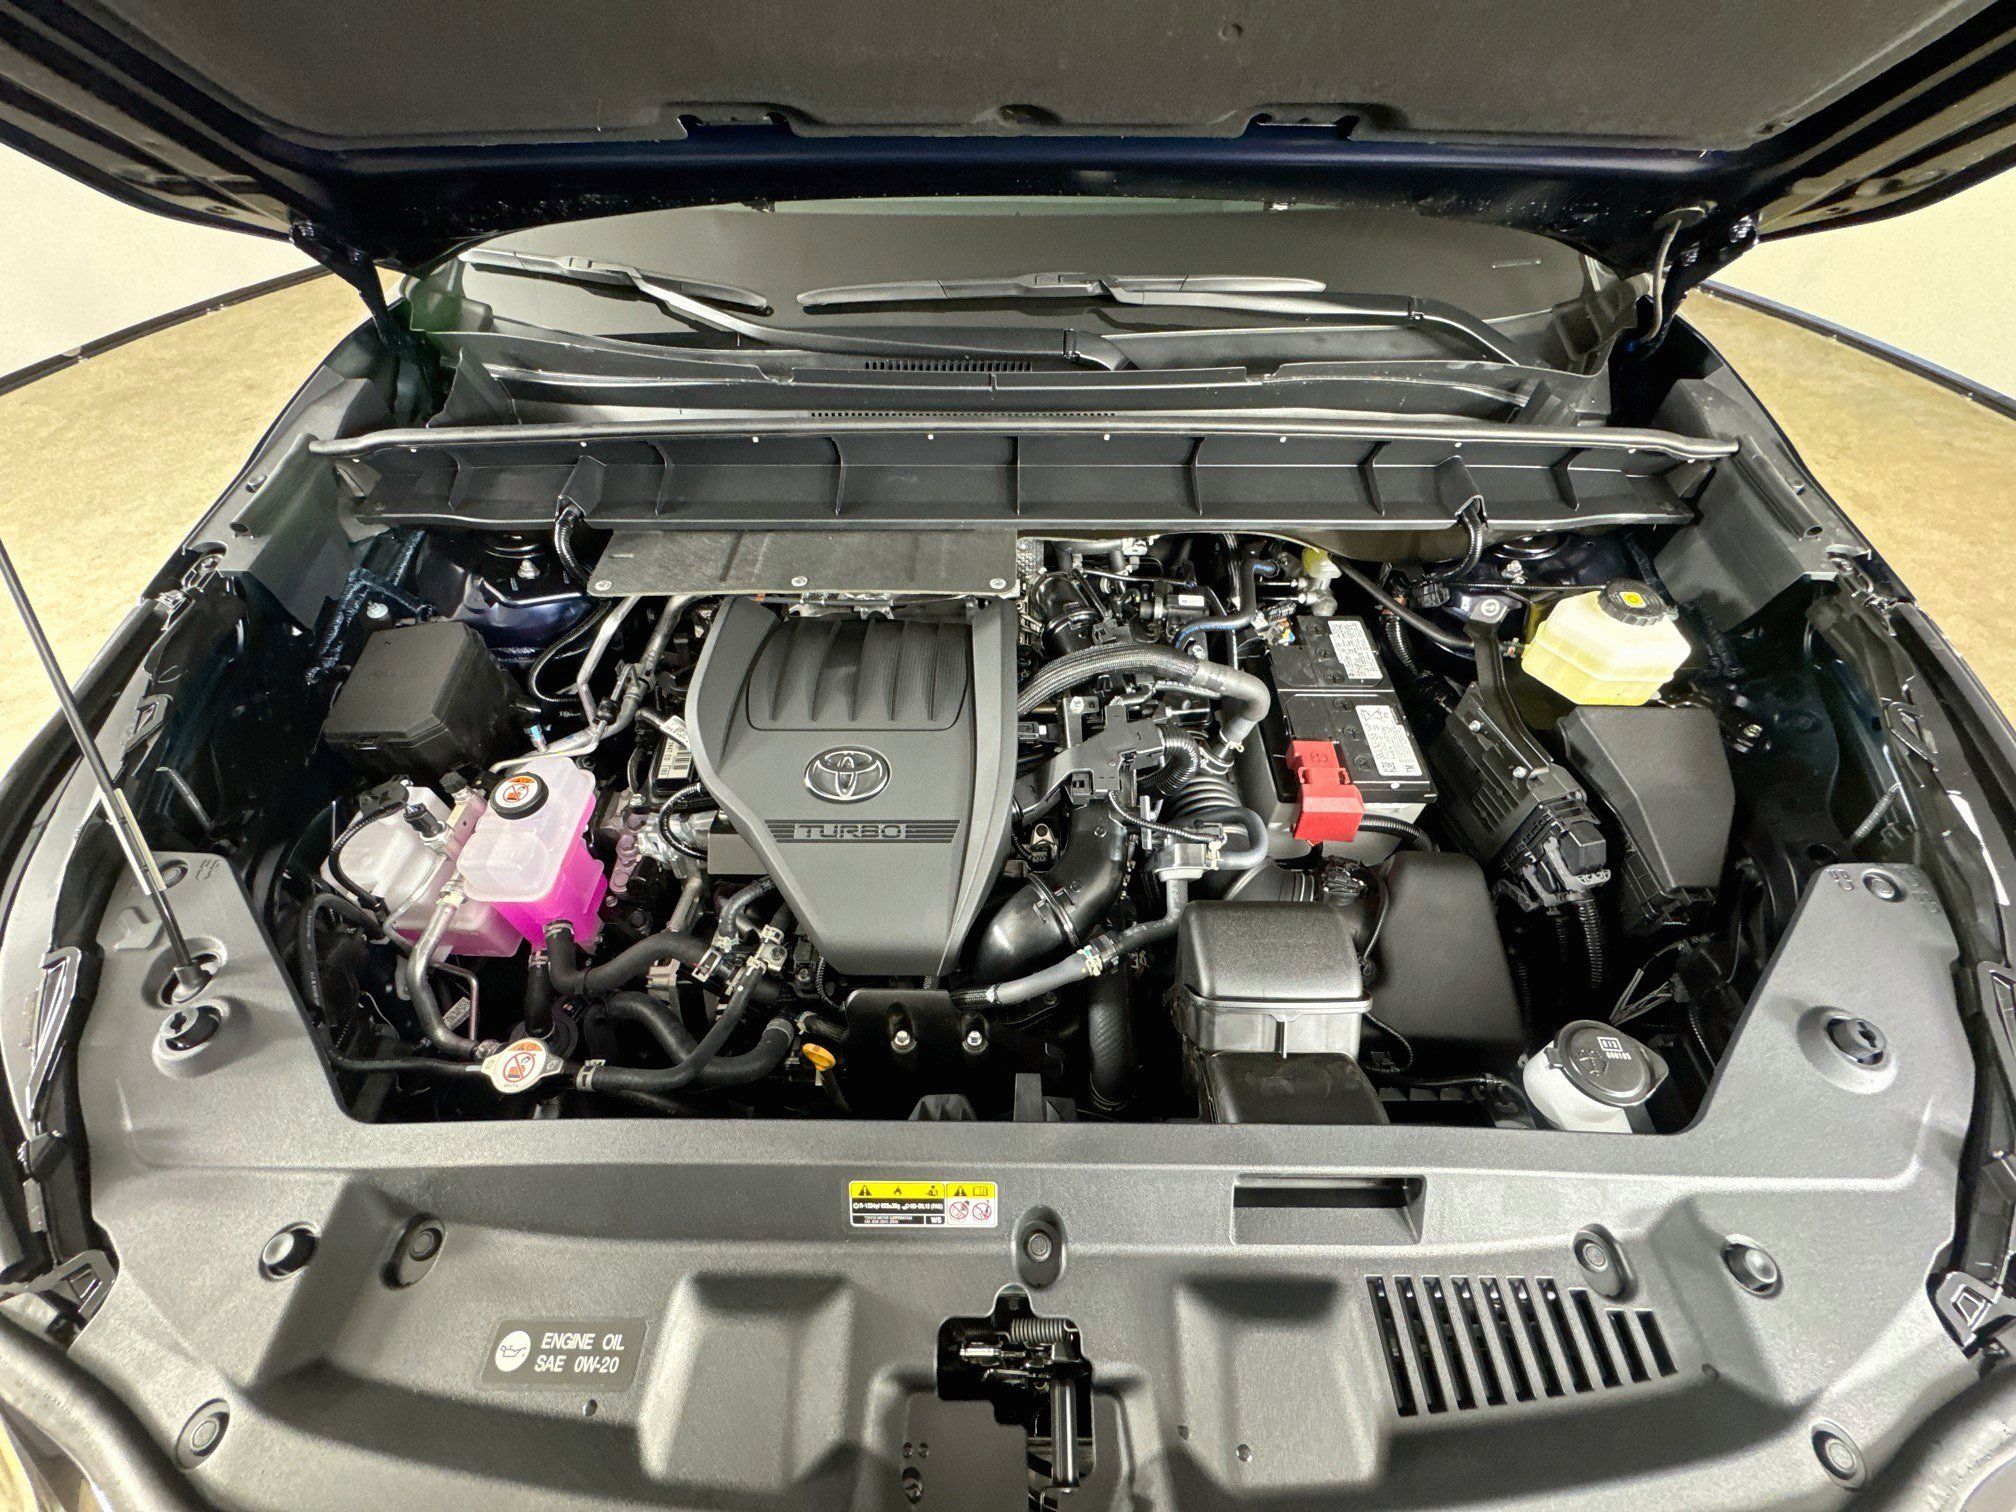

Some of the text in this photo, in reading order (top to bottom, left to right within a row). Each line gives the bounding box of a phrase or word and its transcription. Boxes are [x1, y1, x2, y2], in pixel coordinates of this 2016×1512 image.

[798, 824, 902, 839] TURBO
[930, 1216, 943, 1224] WS
[541, 1332, 625, 1351] ENGINE OIL
[534, 1354, 620, 1374] SAE 0W-20
